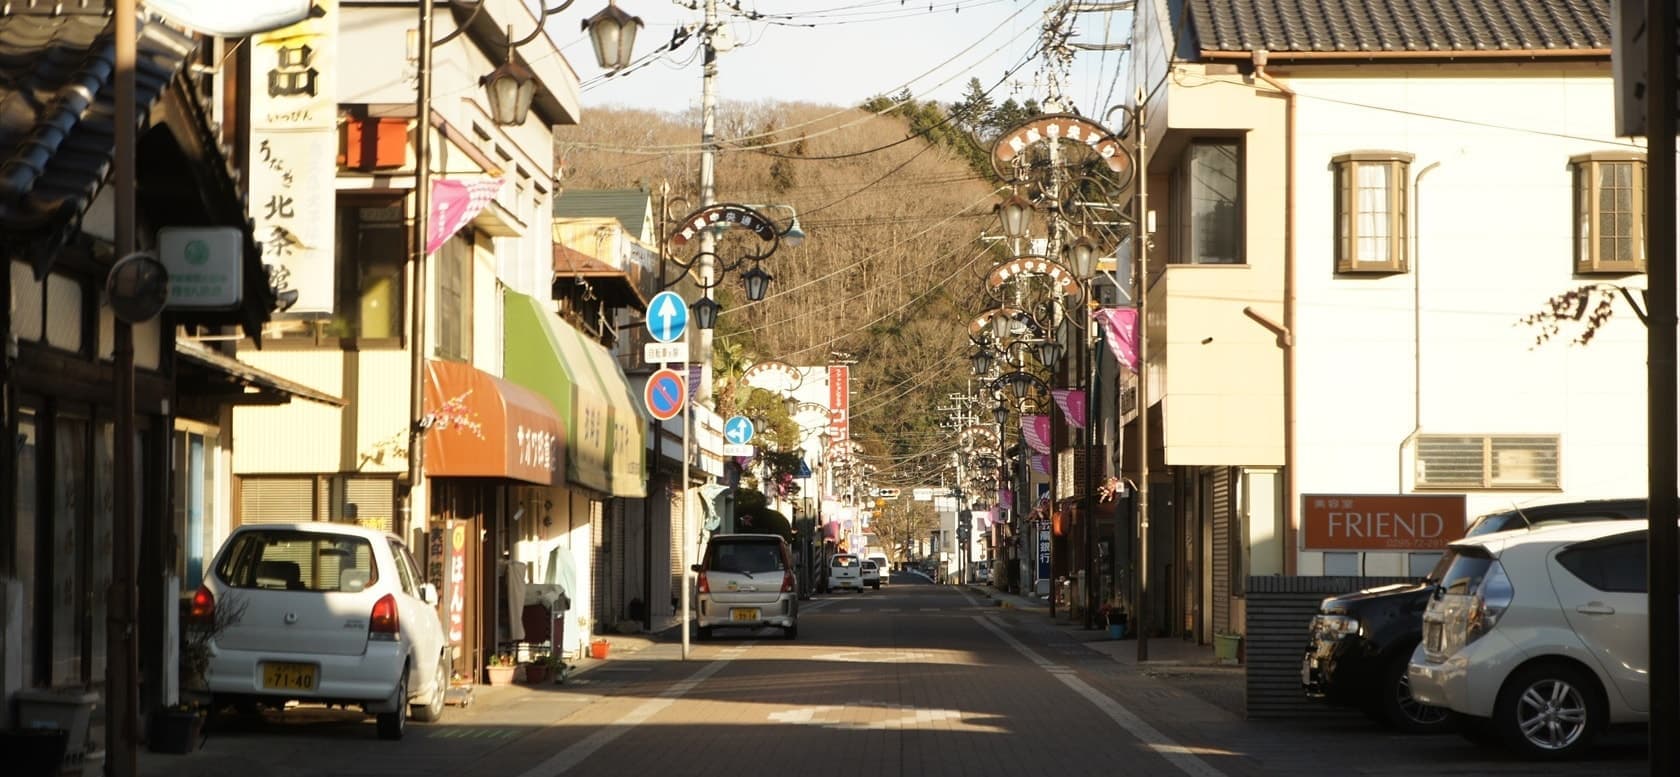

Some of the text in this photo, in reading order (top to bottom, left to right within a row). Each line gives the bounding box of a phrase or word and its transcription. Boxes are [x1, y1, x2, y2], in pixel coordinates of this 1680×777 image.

[1328, 512, 1444, 538] FRIEND
[450, 555, 465, 641] はんこ
[273, 673, 312, 688] 71-40
